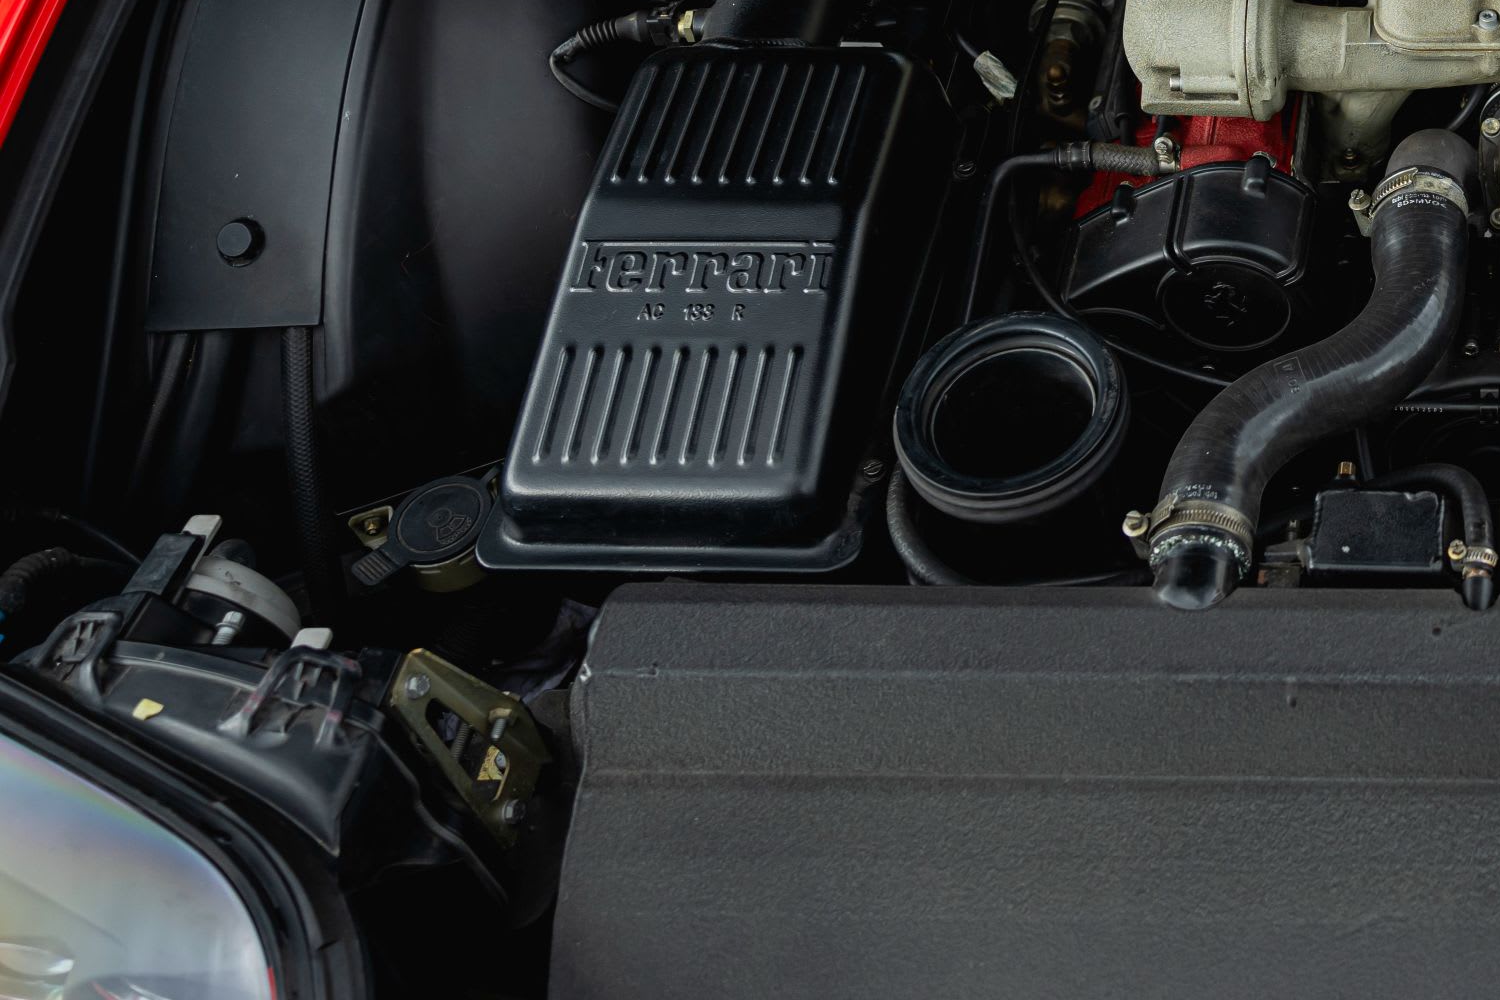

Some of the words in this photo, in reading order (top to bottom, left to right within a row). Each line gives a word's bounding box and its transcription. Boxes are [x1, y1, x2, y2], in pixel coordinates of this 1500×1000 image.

[569, 240, 835, 293] Ferrari
[636, 303, 665, 321] AC
[684, 304, 715, 321] 133
[731, 303, 746, 321] R
